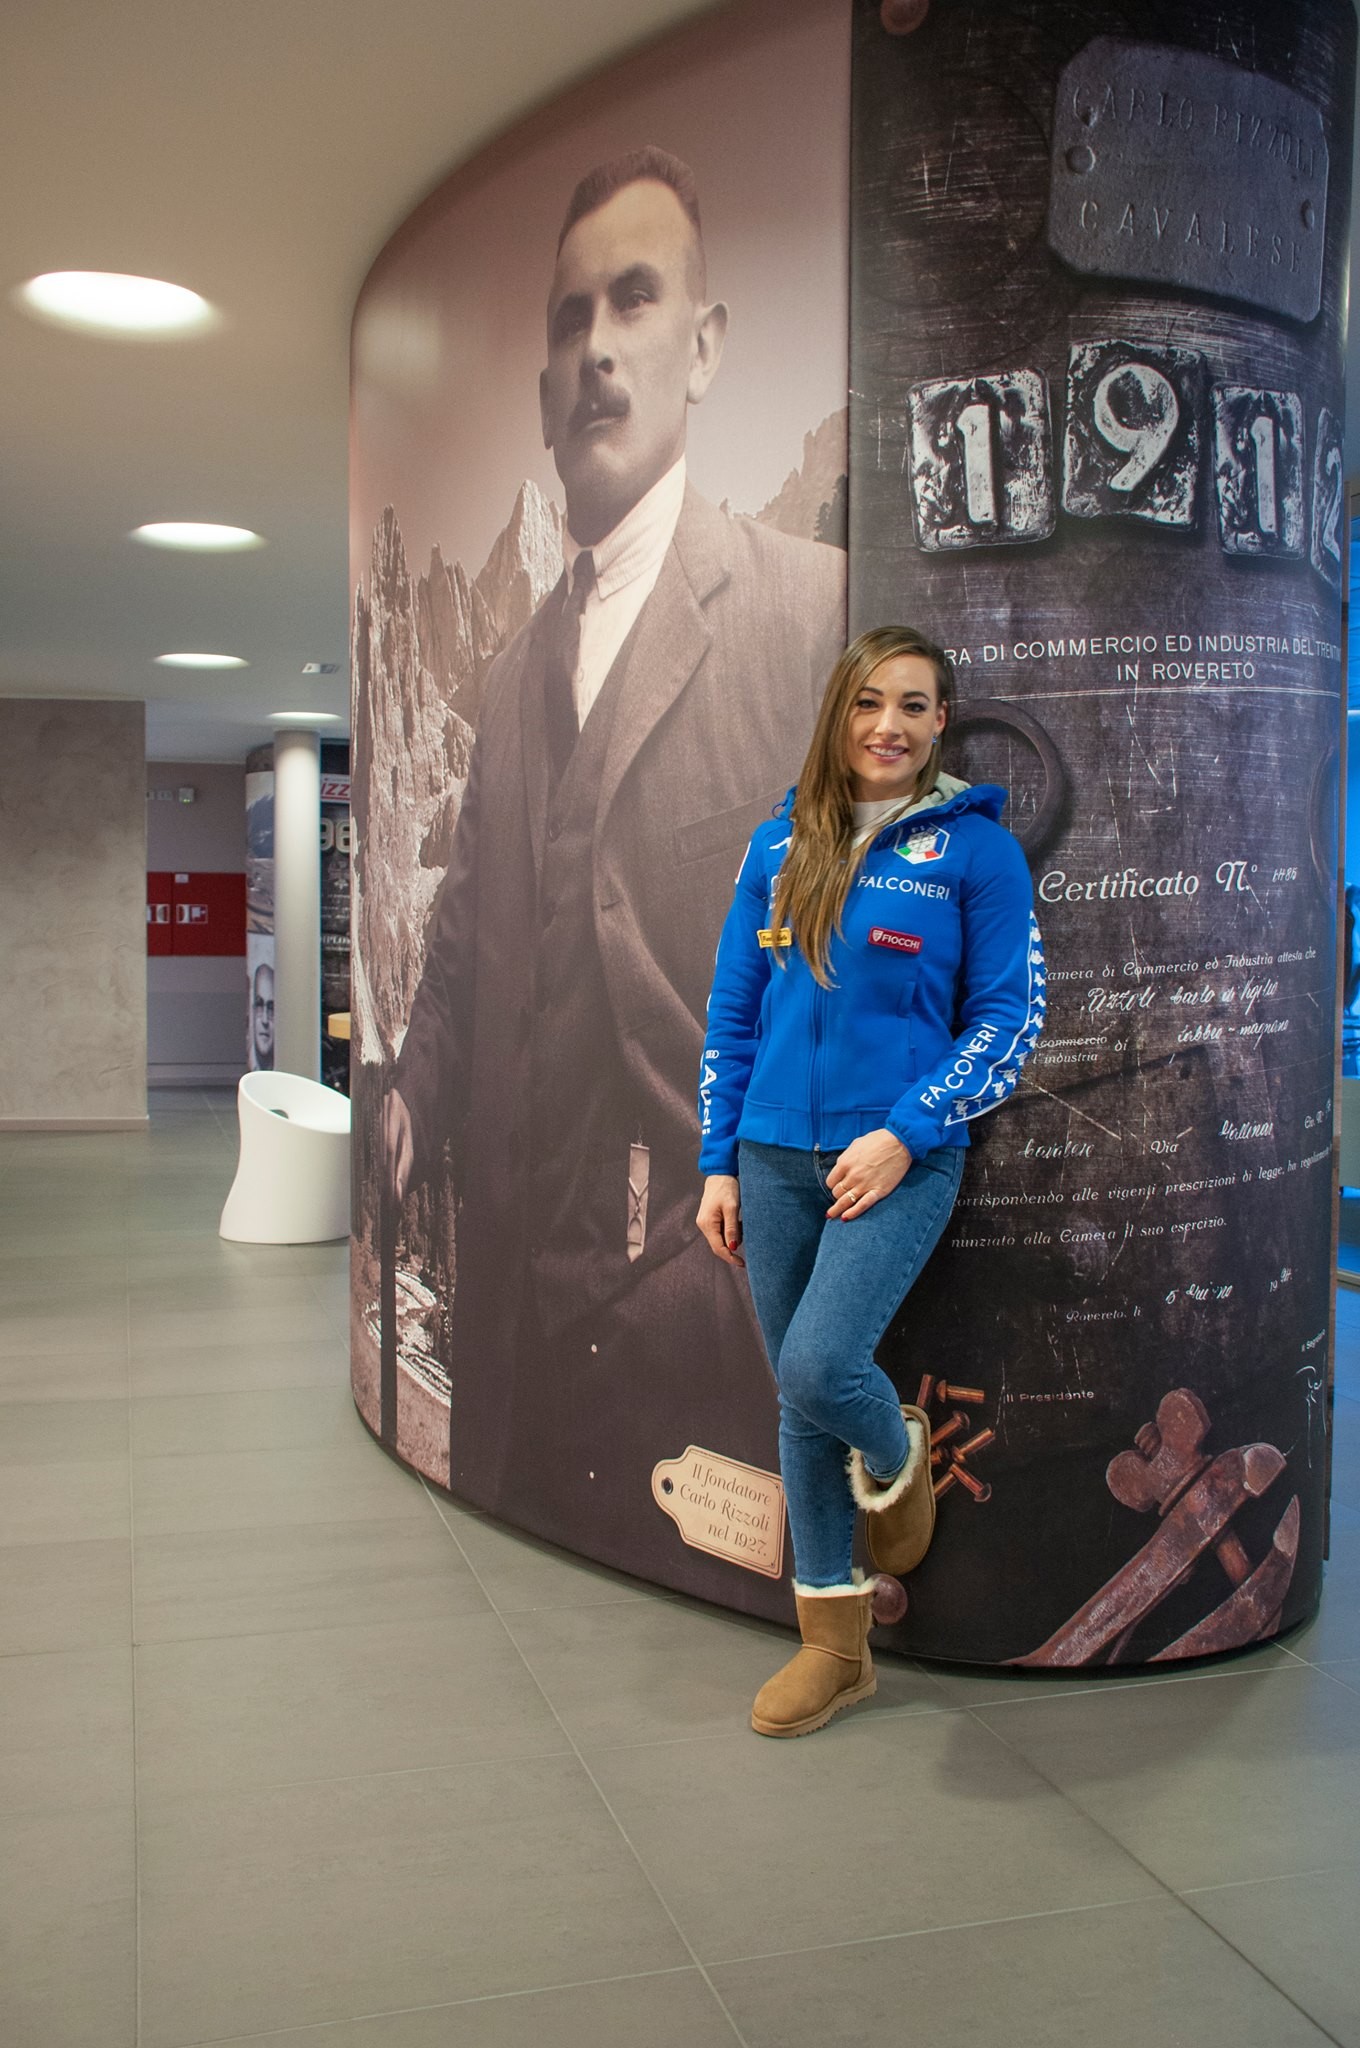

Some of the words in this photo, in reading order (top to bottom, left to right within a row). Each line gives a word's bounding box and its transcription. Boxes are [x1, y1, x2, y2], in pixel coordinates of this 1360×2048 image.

[1072, 83, 1193, 131] CARLO
[1079, 199, 1301, 275] CAVALESE
[944, 648, 972, 667] RA
[983, 644, 1005, 662] DI
[1013, 635, 1158, 660] COMMERCIO
[1165, 635, 1192, 652] ED
[1199, 635, 1289, 654] INDUSTRIA
[1292, 637, 1315, 656] DEL
[1117, 663, 1139, 681] IN
[1152, 662, 1255, 680] ROVERETO
[858, 876, 950, 901] FALCONERI
[1038, 868, 1199, 902] Certificato
[882, 934, 920, 950] FIOCCHI
[1102, 964, 1115, 978] di
[1123, 960, 1199, 977] Commercio
[1205, 959, 1219, 970] ed
[1224, 952, 1274, 969] Industria
[1114, 1037, 1129, 1051] di
[1150, 1140, 1179, 1154] Via
[954, 1191, 1064, 1208] orrispondendo
[1072, 1187, 1099, 1202] alle
[1165, 1173, 1237, 1196] prescrizioni
[1242, 1169, 1253, 1182] di
[1023, 1232, 1051, 1245] alla
[1060, 1228, 1116, 1243] Camera
[1140, 1226, 1164, 1237] suo
[1020, 1389, 1095, 1402] Presidente
[692, 1463, 702, 1481] Il
[701, 1467, 772, 1506] fondatore
[680, 1483, 716, 1511] Carlo
[721, 1498, 771, 1531] Rizzoli
[708, 1523, 730, 1541] nel
[734, 1531, 767, 1557] 1927.
